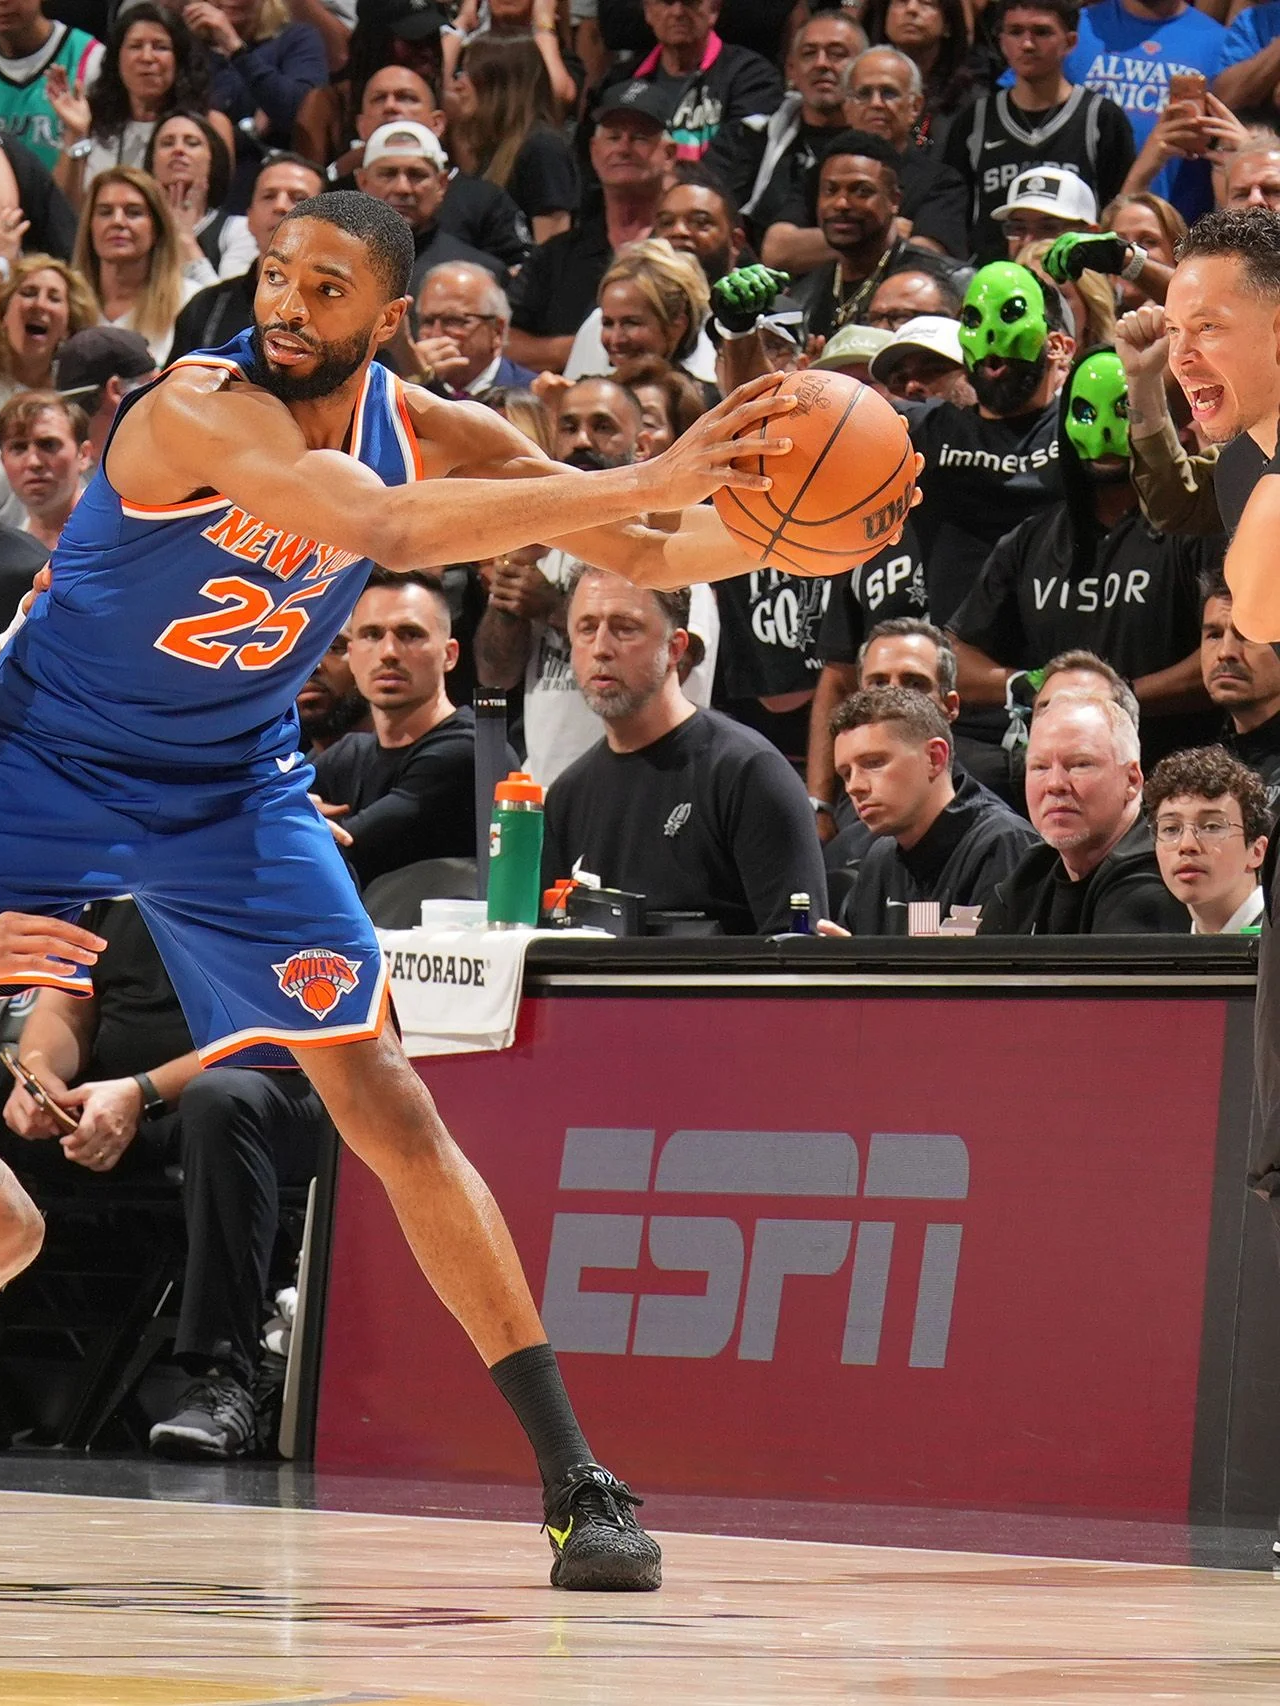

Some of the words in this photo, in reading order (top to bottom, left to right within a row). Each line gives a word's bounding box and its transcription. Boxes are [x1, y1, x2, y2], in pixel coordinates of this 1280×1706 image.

[938, 444, 1059, 473] immerse
[200, 505, 318, 582] NEW
[1033, 569, 1150, 612] VISOR
[153, 576, 337, 670] 25
[282, 956, 356, 988] KNICKS
[384, 951, 485, 987] ATORADE
[539, 1127, 969, 1368] ESPN
